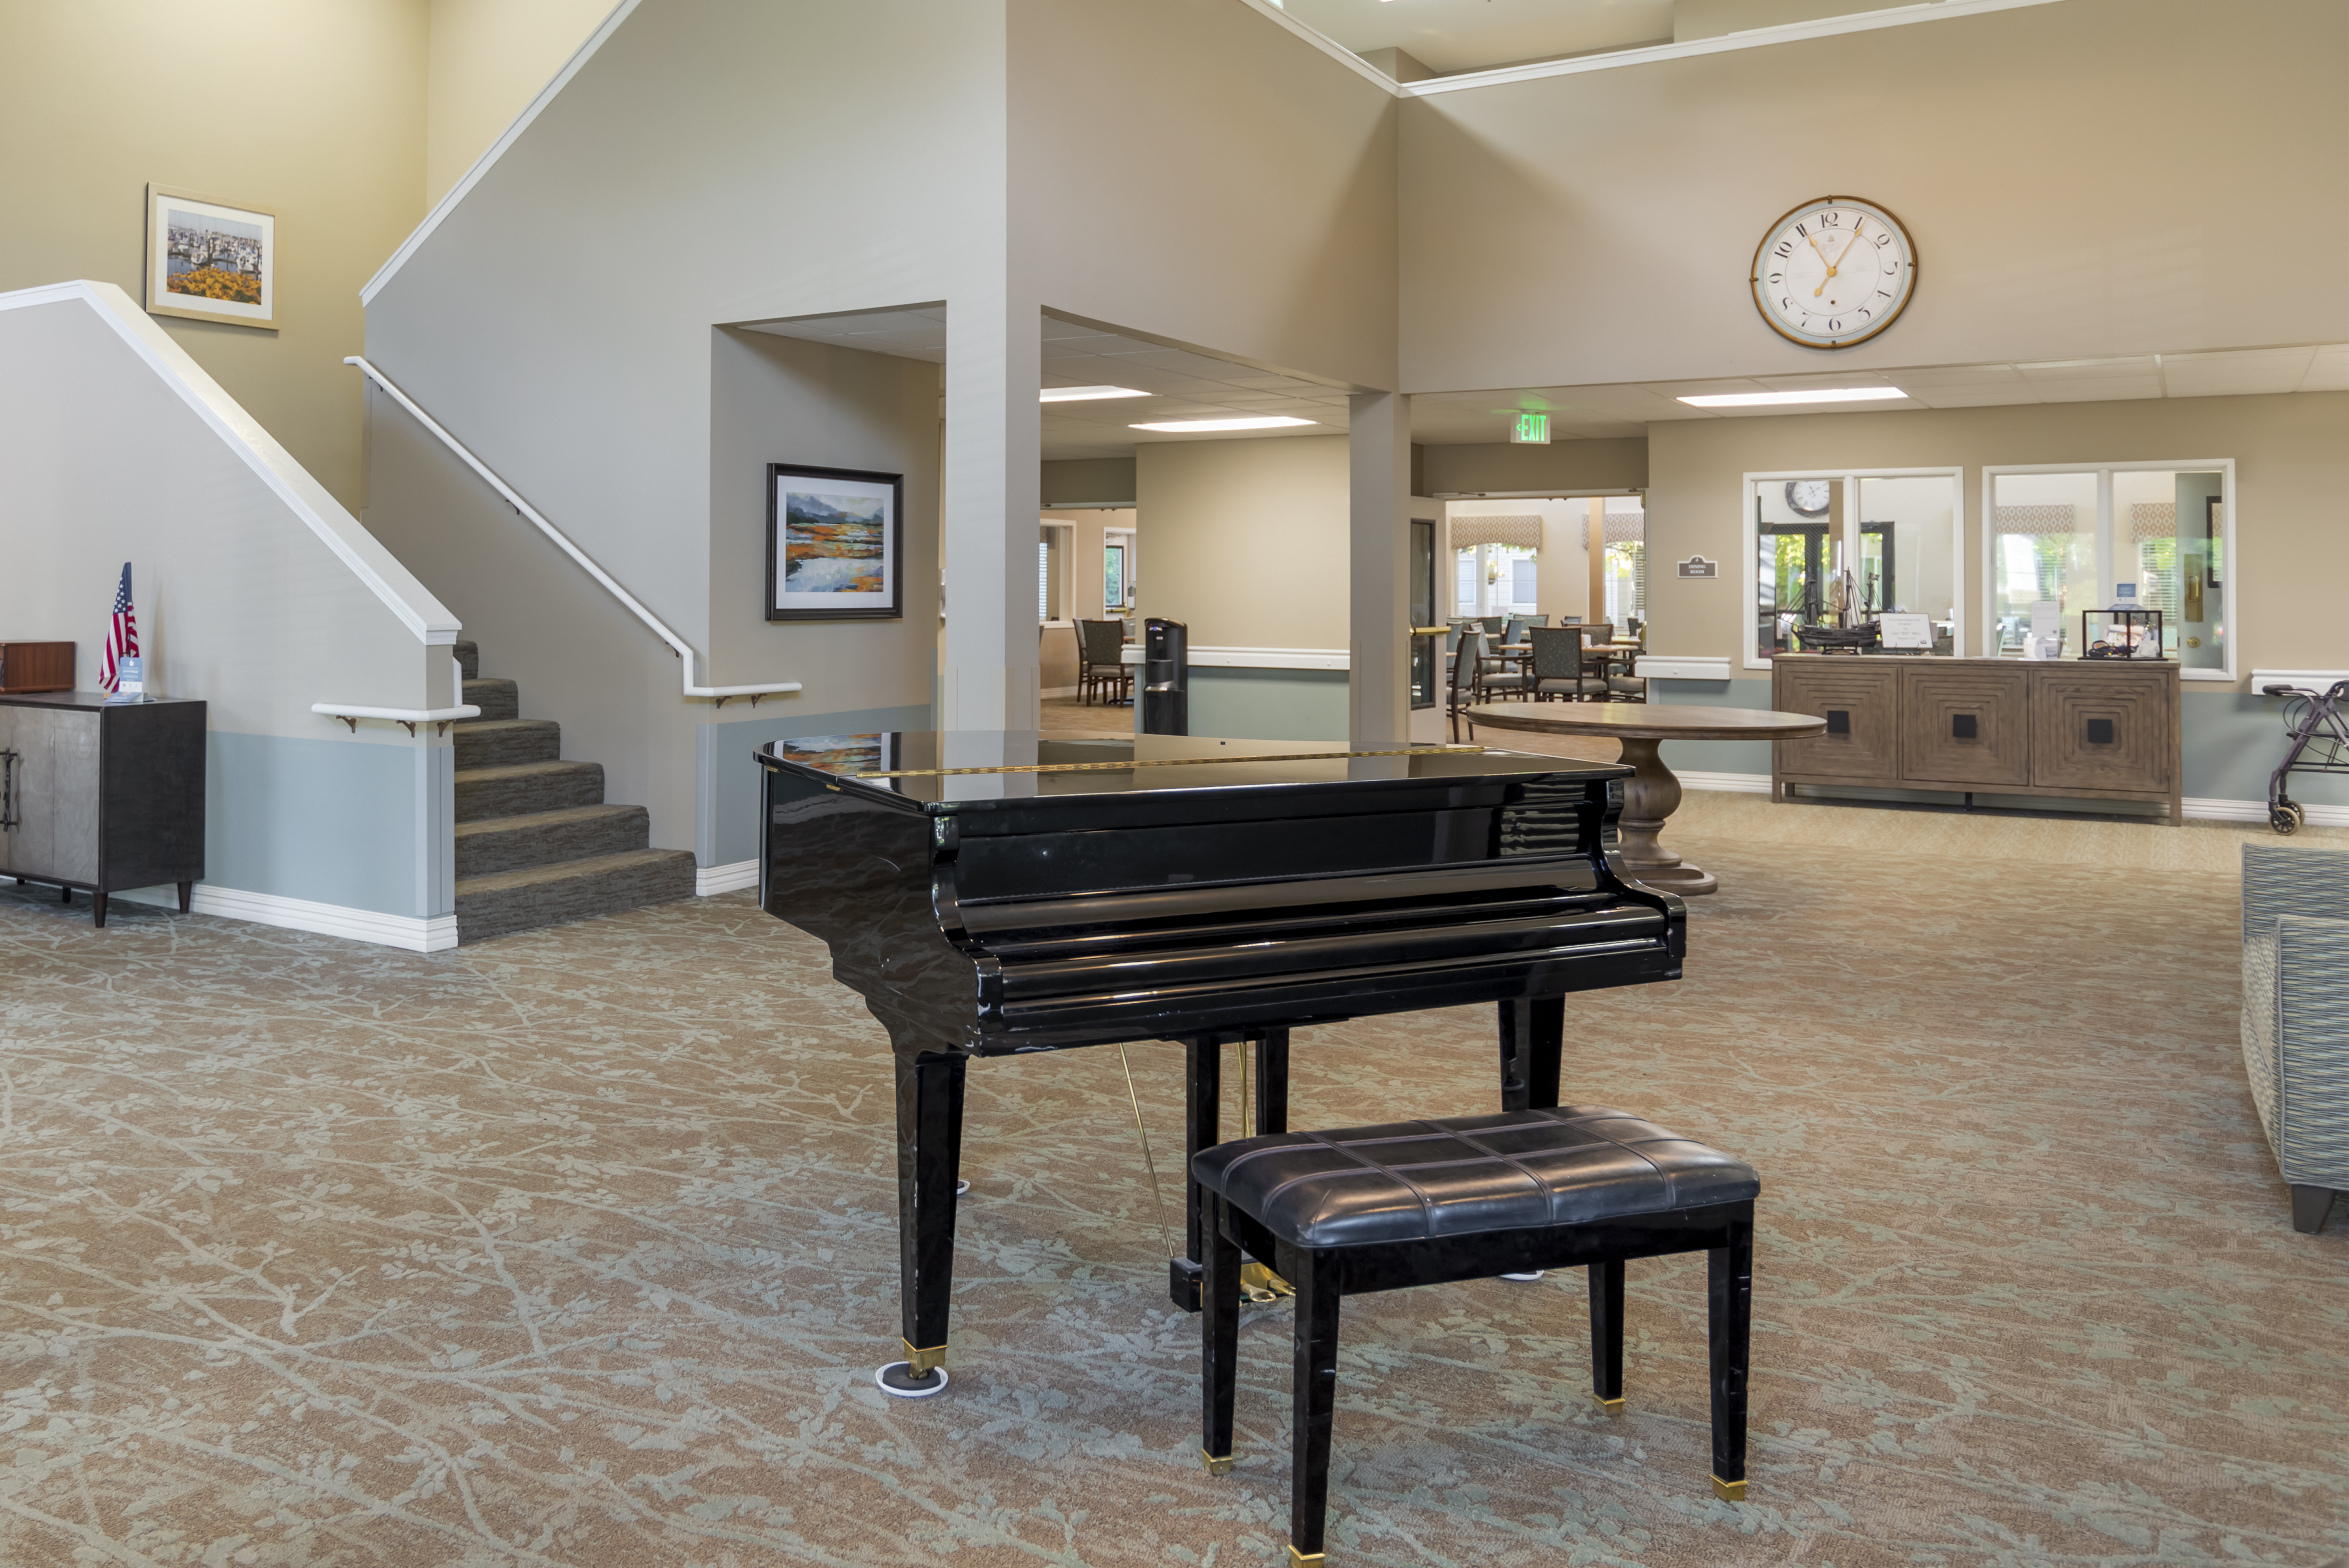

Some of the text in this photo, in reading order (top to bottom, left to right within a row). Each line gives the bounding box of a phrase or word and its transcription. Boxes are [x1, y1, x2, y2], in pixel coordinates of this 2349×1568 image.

[1821, 212, 1838, 228] 12
[1854, 217, 1863, 230] 1
[1873, 234, 1890, 249] 2
[1774, 242, 1792, 258] 10
[1883, 261, 1898, 275] 3
[1769, 273, 1783, 284] 9
[1799, 312, 1813, 327] 7
[1857, 305, 1871, 322] 5
[1829, 316, 1844, 332] 6
[1521, 414, 1546, 441] EXIT
